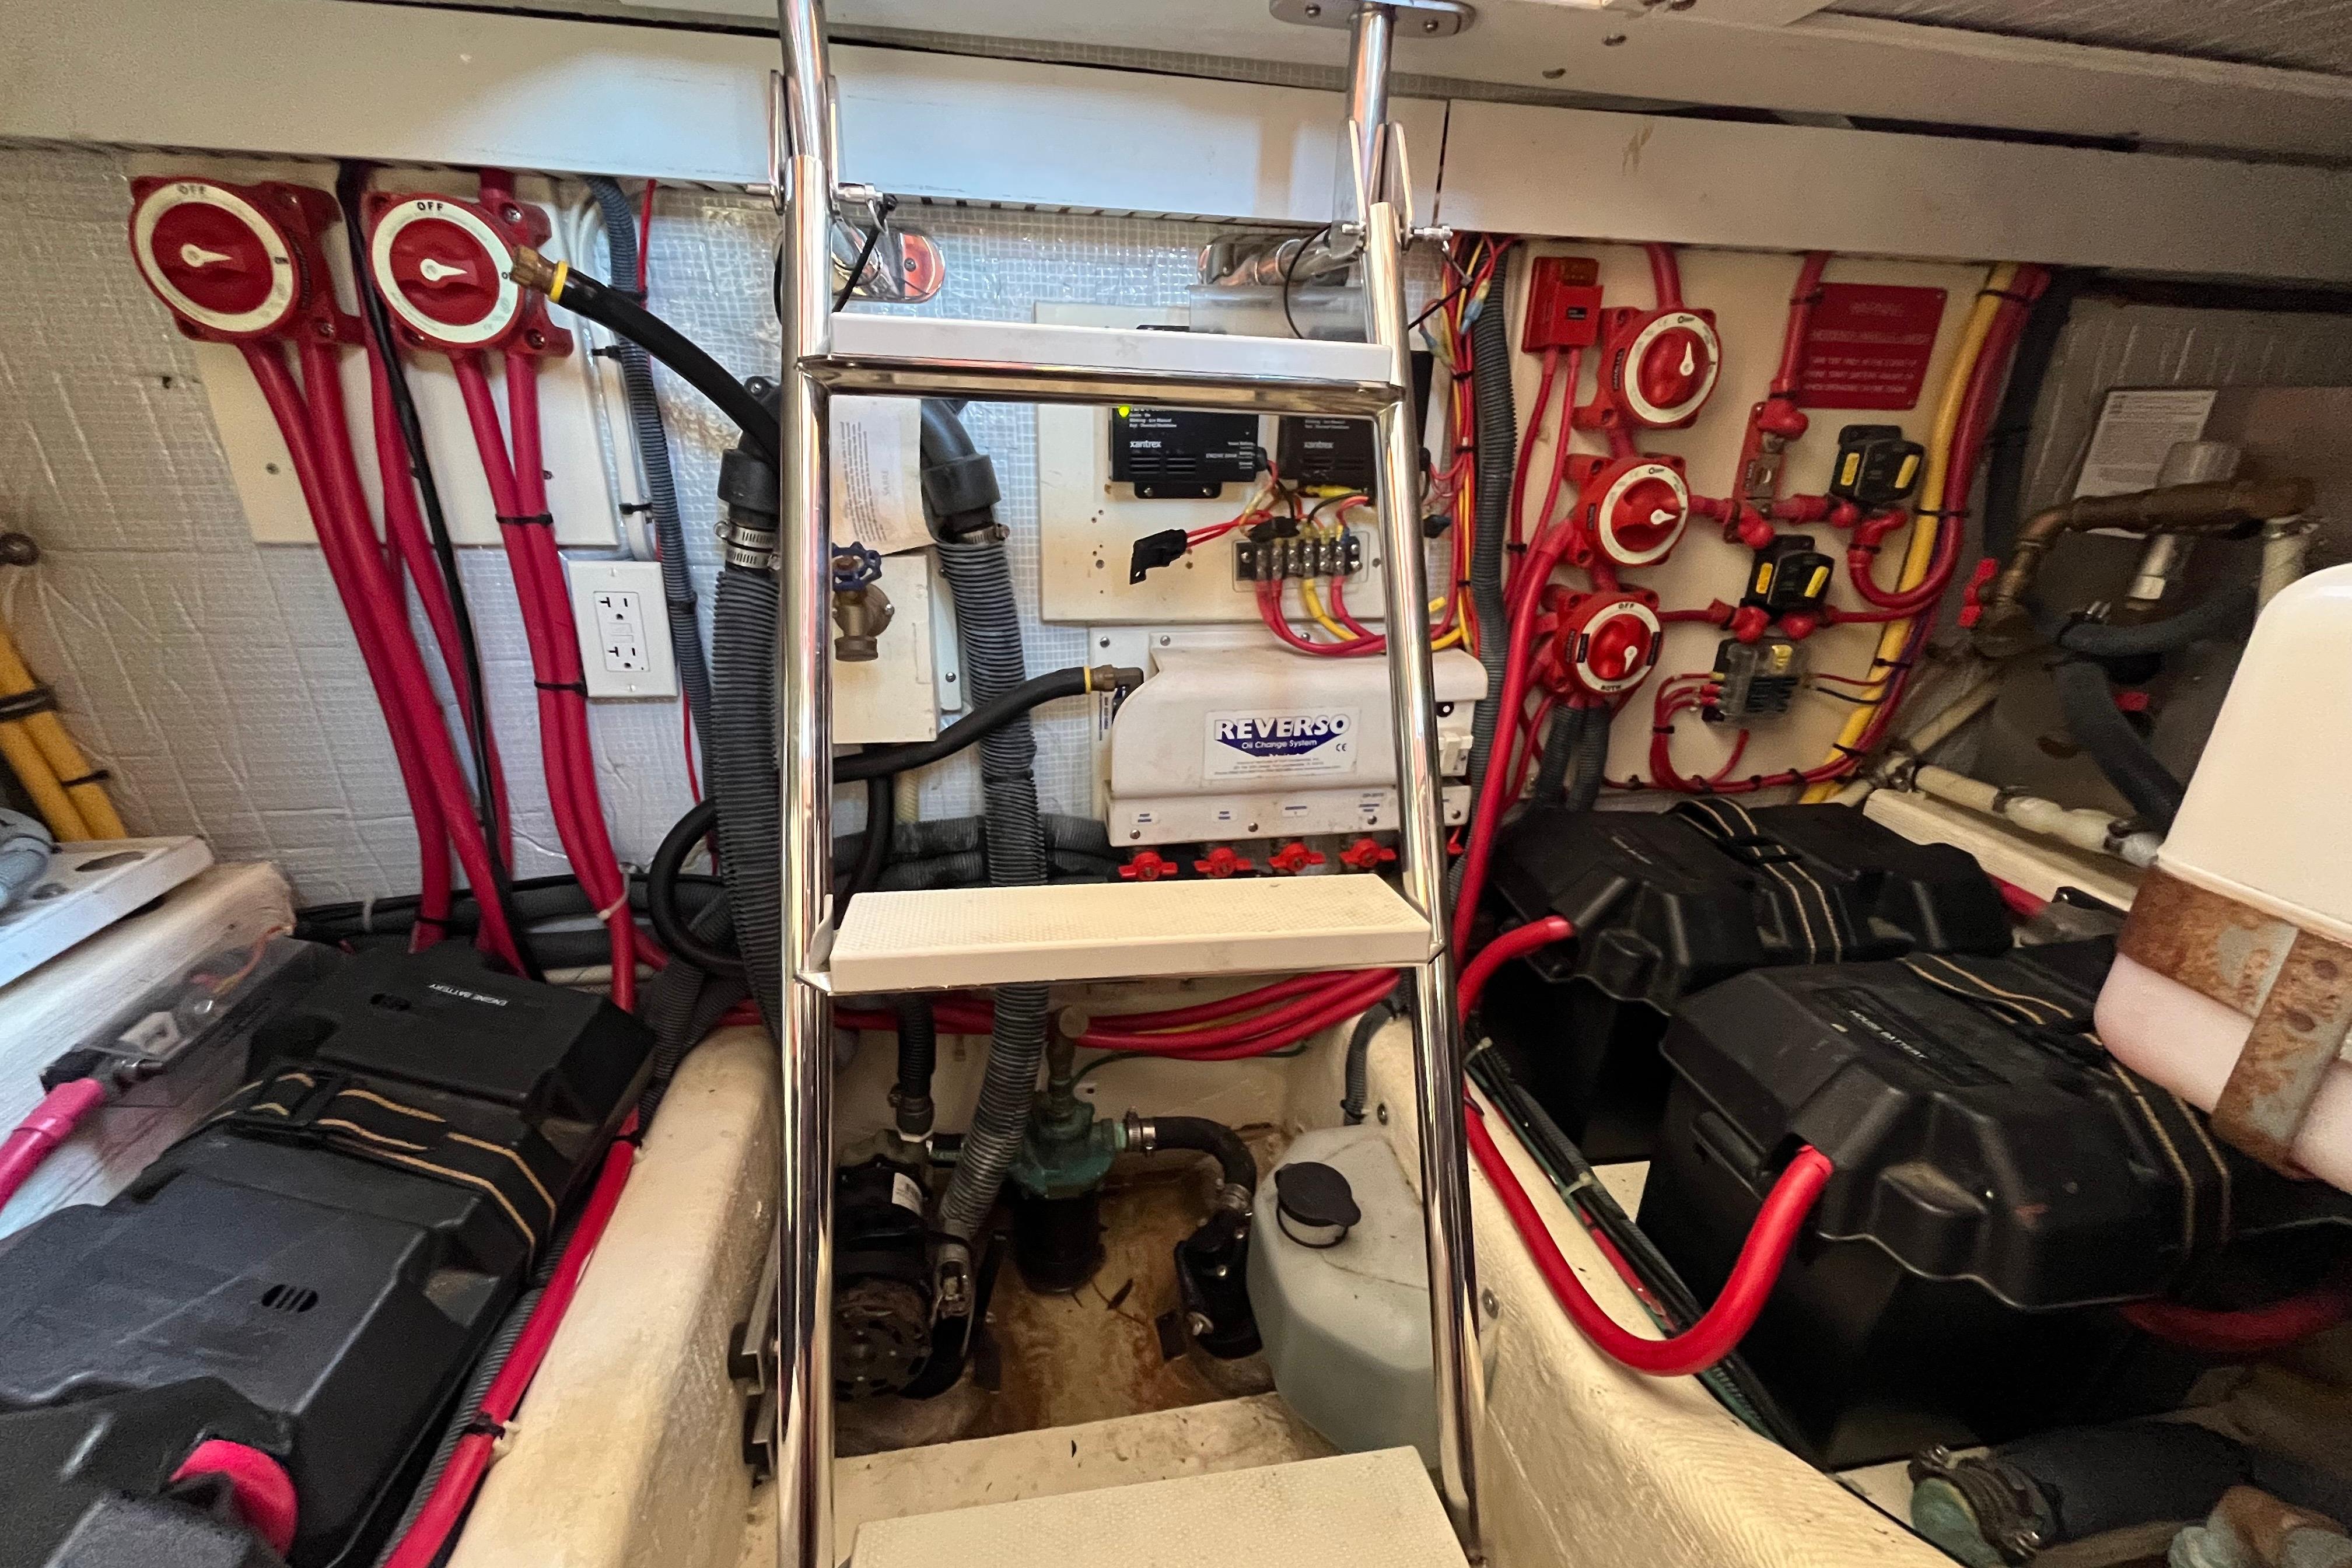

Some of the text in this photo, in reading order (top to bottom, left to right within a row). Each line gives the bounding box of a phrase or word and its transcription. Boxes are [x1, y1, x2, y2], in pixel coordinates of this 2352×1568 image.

[416, 202, 444, 211] OFF
[1214, 713, 1351, 740] REVERSO
[1241, 739, 1318, 750] Oil Change System
[428, 984, 473, 998] BATTERY
[1880, 1031, 1927, 1059] BATTERY
